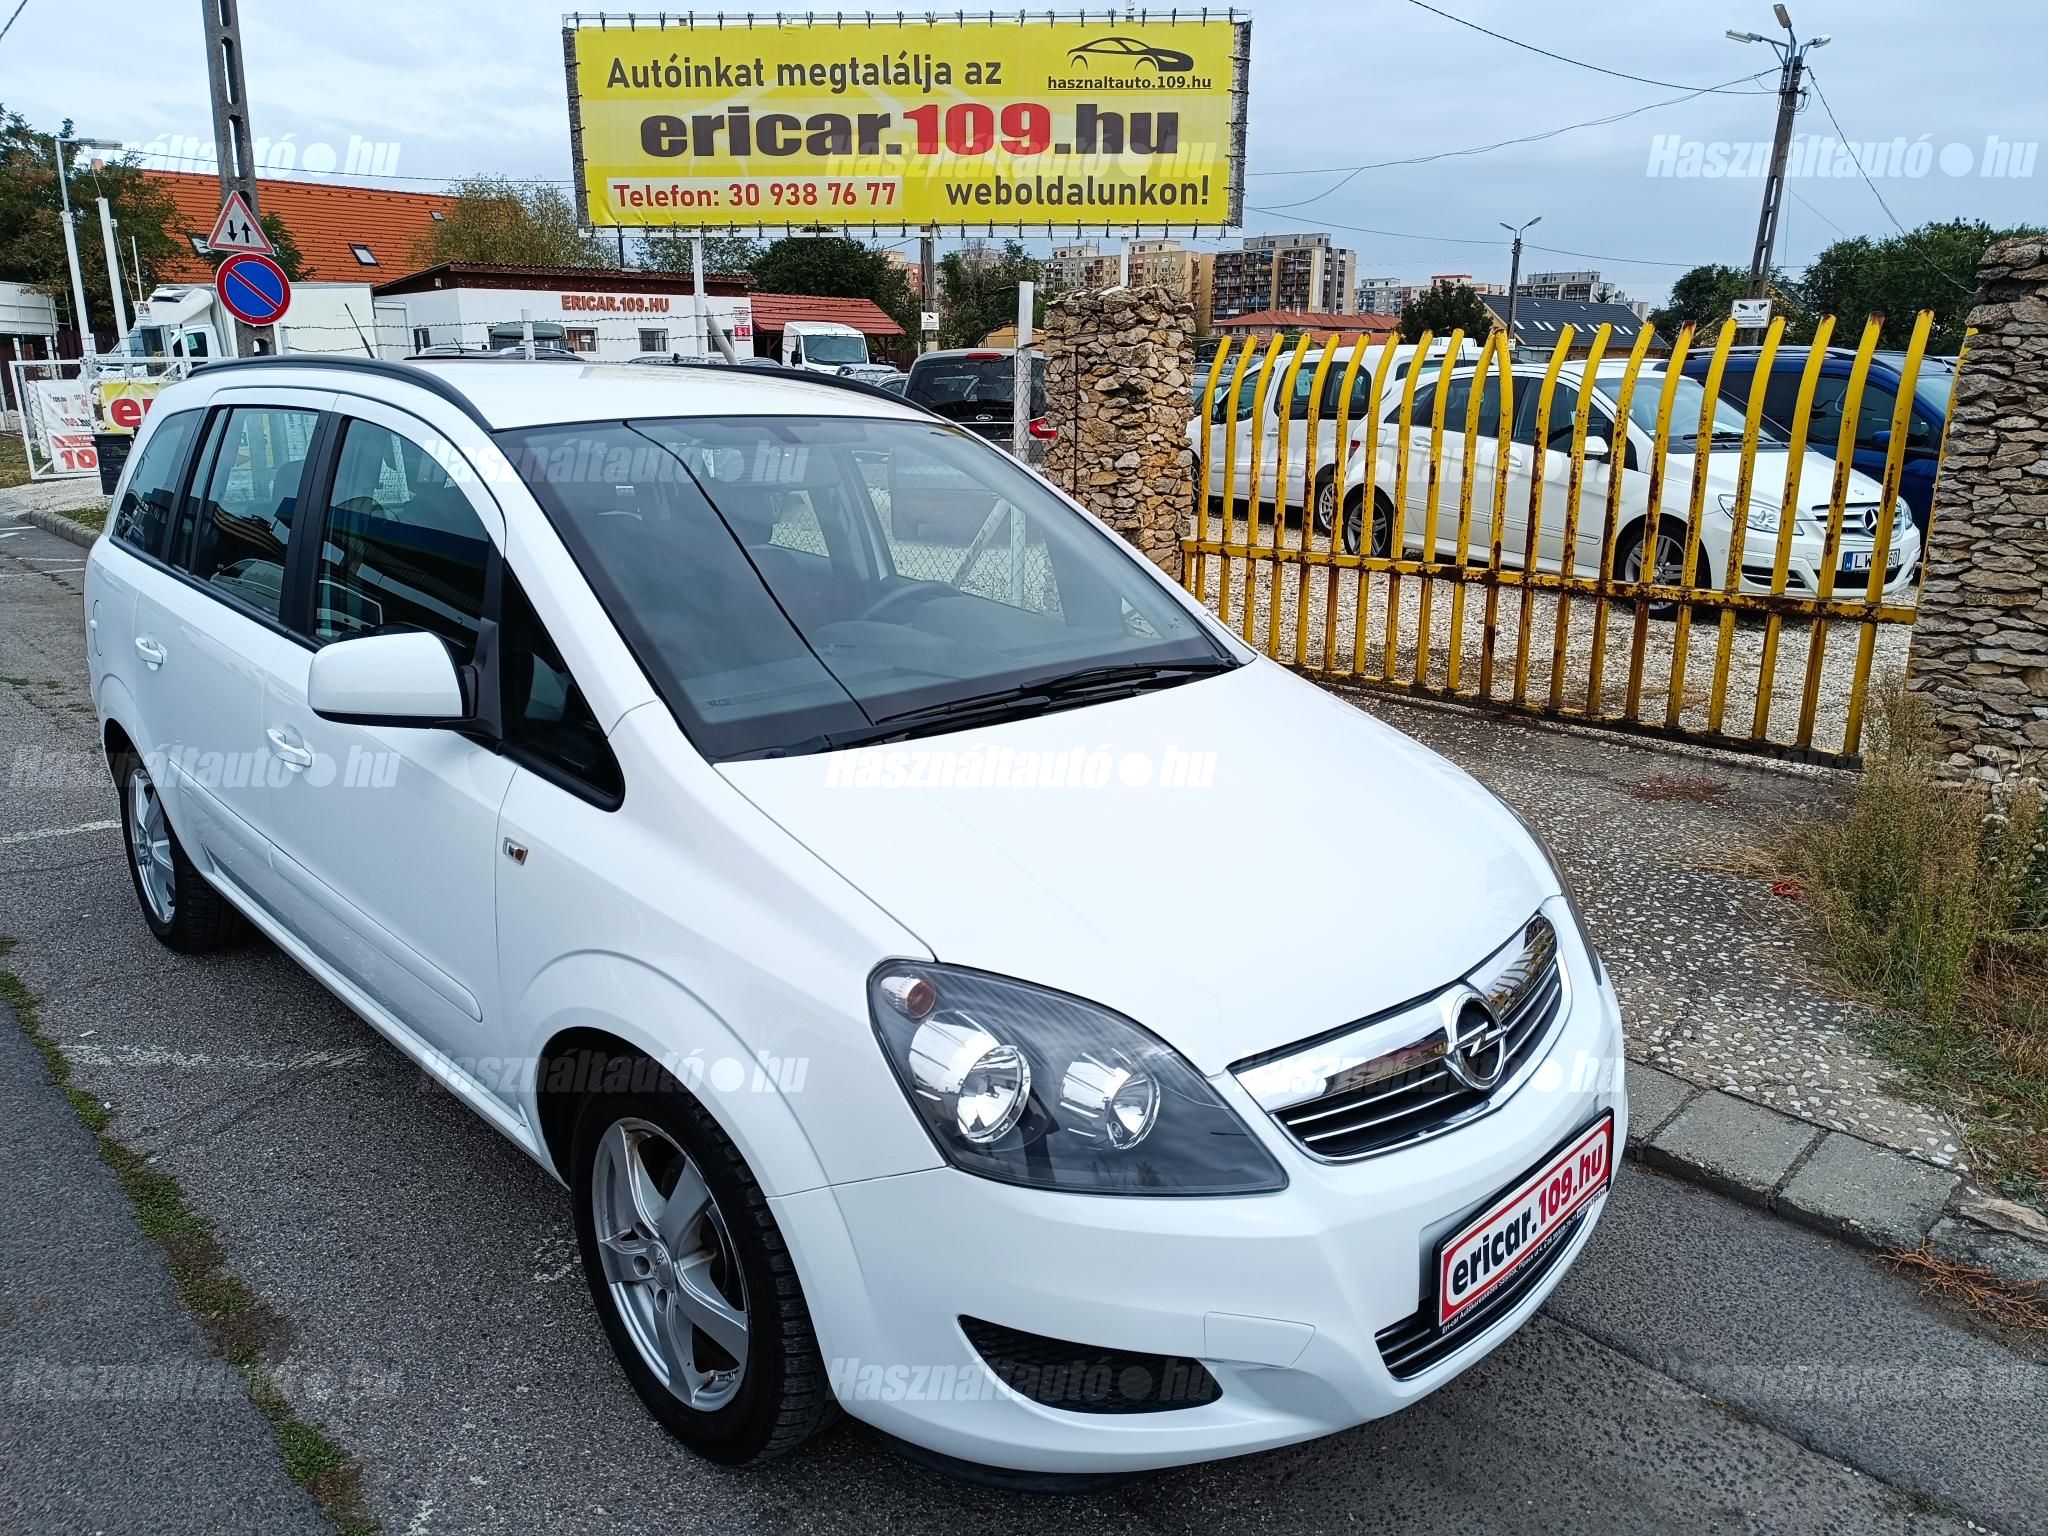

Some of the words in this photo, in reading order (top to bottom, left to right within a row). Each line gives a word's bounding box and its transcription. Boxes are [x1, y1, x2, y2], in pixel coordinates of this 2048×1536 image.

[607, 53, 765, 89] Autóinkat
[777, 51, 951, 94] megtalálja
[965, 62, 1002, 84] az
[1047, 75, 1212, 88] hasznaltauto.109.hu
[640, 103, 1179, 157] ericar.109.hu
[613, 184, 719, 207] Telefon:
[729, 183, 760, 206] 30
[770, 183, 817, 206] 938
[828, 182, 857, 205] 76
[866, 182, 896, 205] 77
[946, 175, 1209, 206] weboldalunkon!
[561, 295, 670, 312] ERICAR.109.HU
[1452, 1144, 1604, 1296] ericar.109.hu
